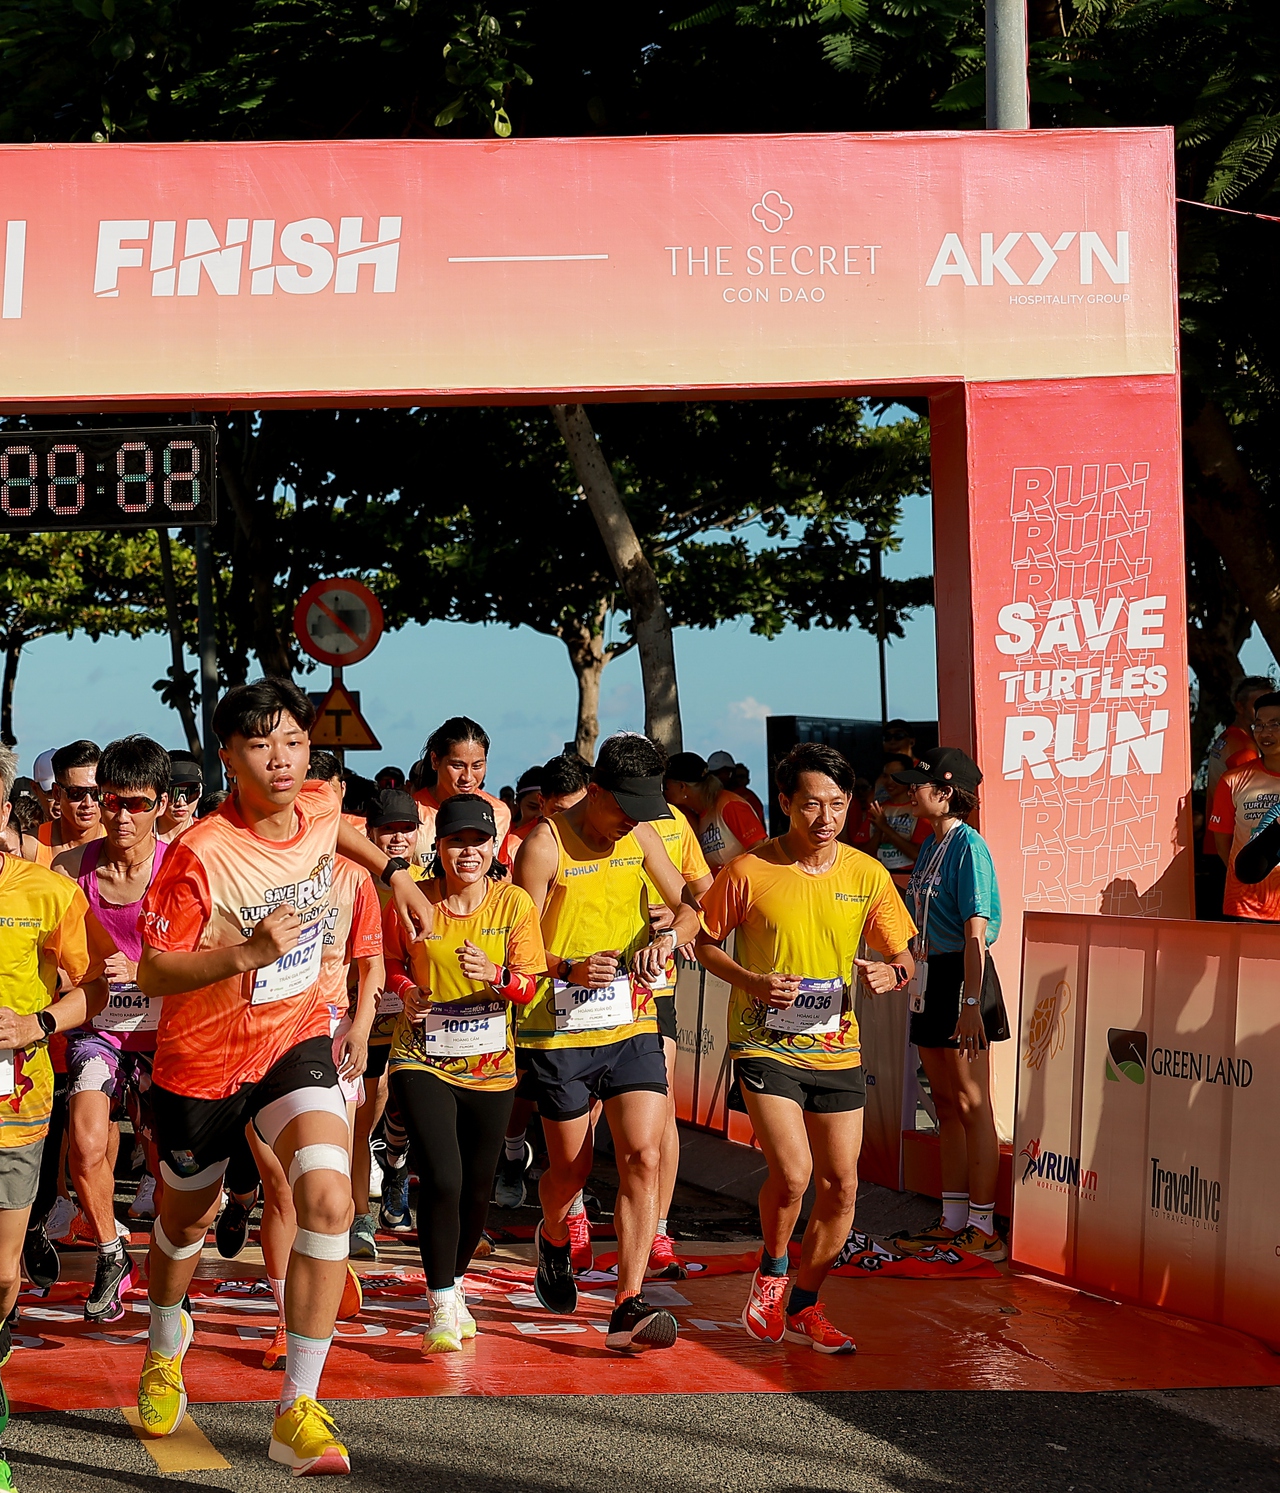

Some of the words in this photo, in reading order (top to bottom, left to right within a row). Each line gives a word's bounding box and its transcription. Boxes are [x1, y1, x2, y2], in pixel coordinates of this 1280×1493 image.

[95, 216, 403, 297] FINISH
[665, 246, 733, 277] THE
[746, 245, 882, 276] SECRET
[925, 231, 1130, 287] AKYN
[723, 287, 770, 303] CON
[780, 287, 826, 303] DAO
[1009, 294, 1084, 305] HOSPITALITY
[1087, 293, 1130, 304] GROUP
[1010, 462, 1150, 519] RUN
[1010, 510, 1151, 568] RUN
[995, 596, 1167, 655] SAVE
[999, 666, 1168, 702] TURTLES
[1001, 709, 1170, 781] RUN
[610, 858, 624, 868] PFG
[264, 884, 296, 904] SAVE
[276, 943, 317, 973] 10027
[488, 1002, 500, 1011] 10
[571, 986, 616, 1005] 10033
[794, 994, 832, 1009] 0036
[441, 1017, 489, 1033] 10034
[1151, 1047, 1203, 1081] GREEN
[1205, 1054, 1253, 1088] LAND
[1036, 1180, 1053, 1191] MORE
[1055, 1185, 1071, 1196] THAN
[1080, 1191, 1096, 1202] RACE
[1151, 1209, 1159, 1218] TO
[1163, 1211, 1188, 1225] TRAVEL
[1192, 1219, 1200, 1228] TO
[1203, 1222, 1219, 1233] LIVE
